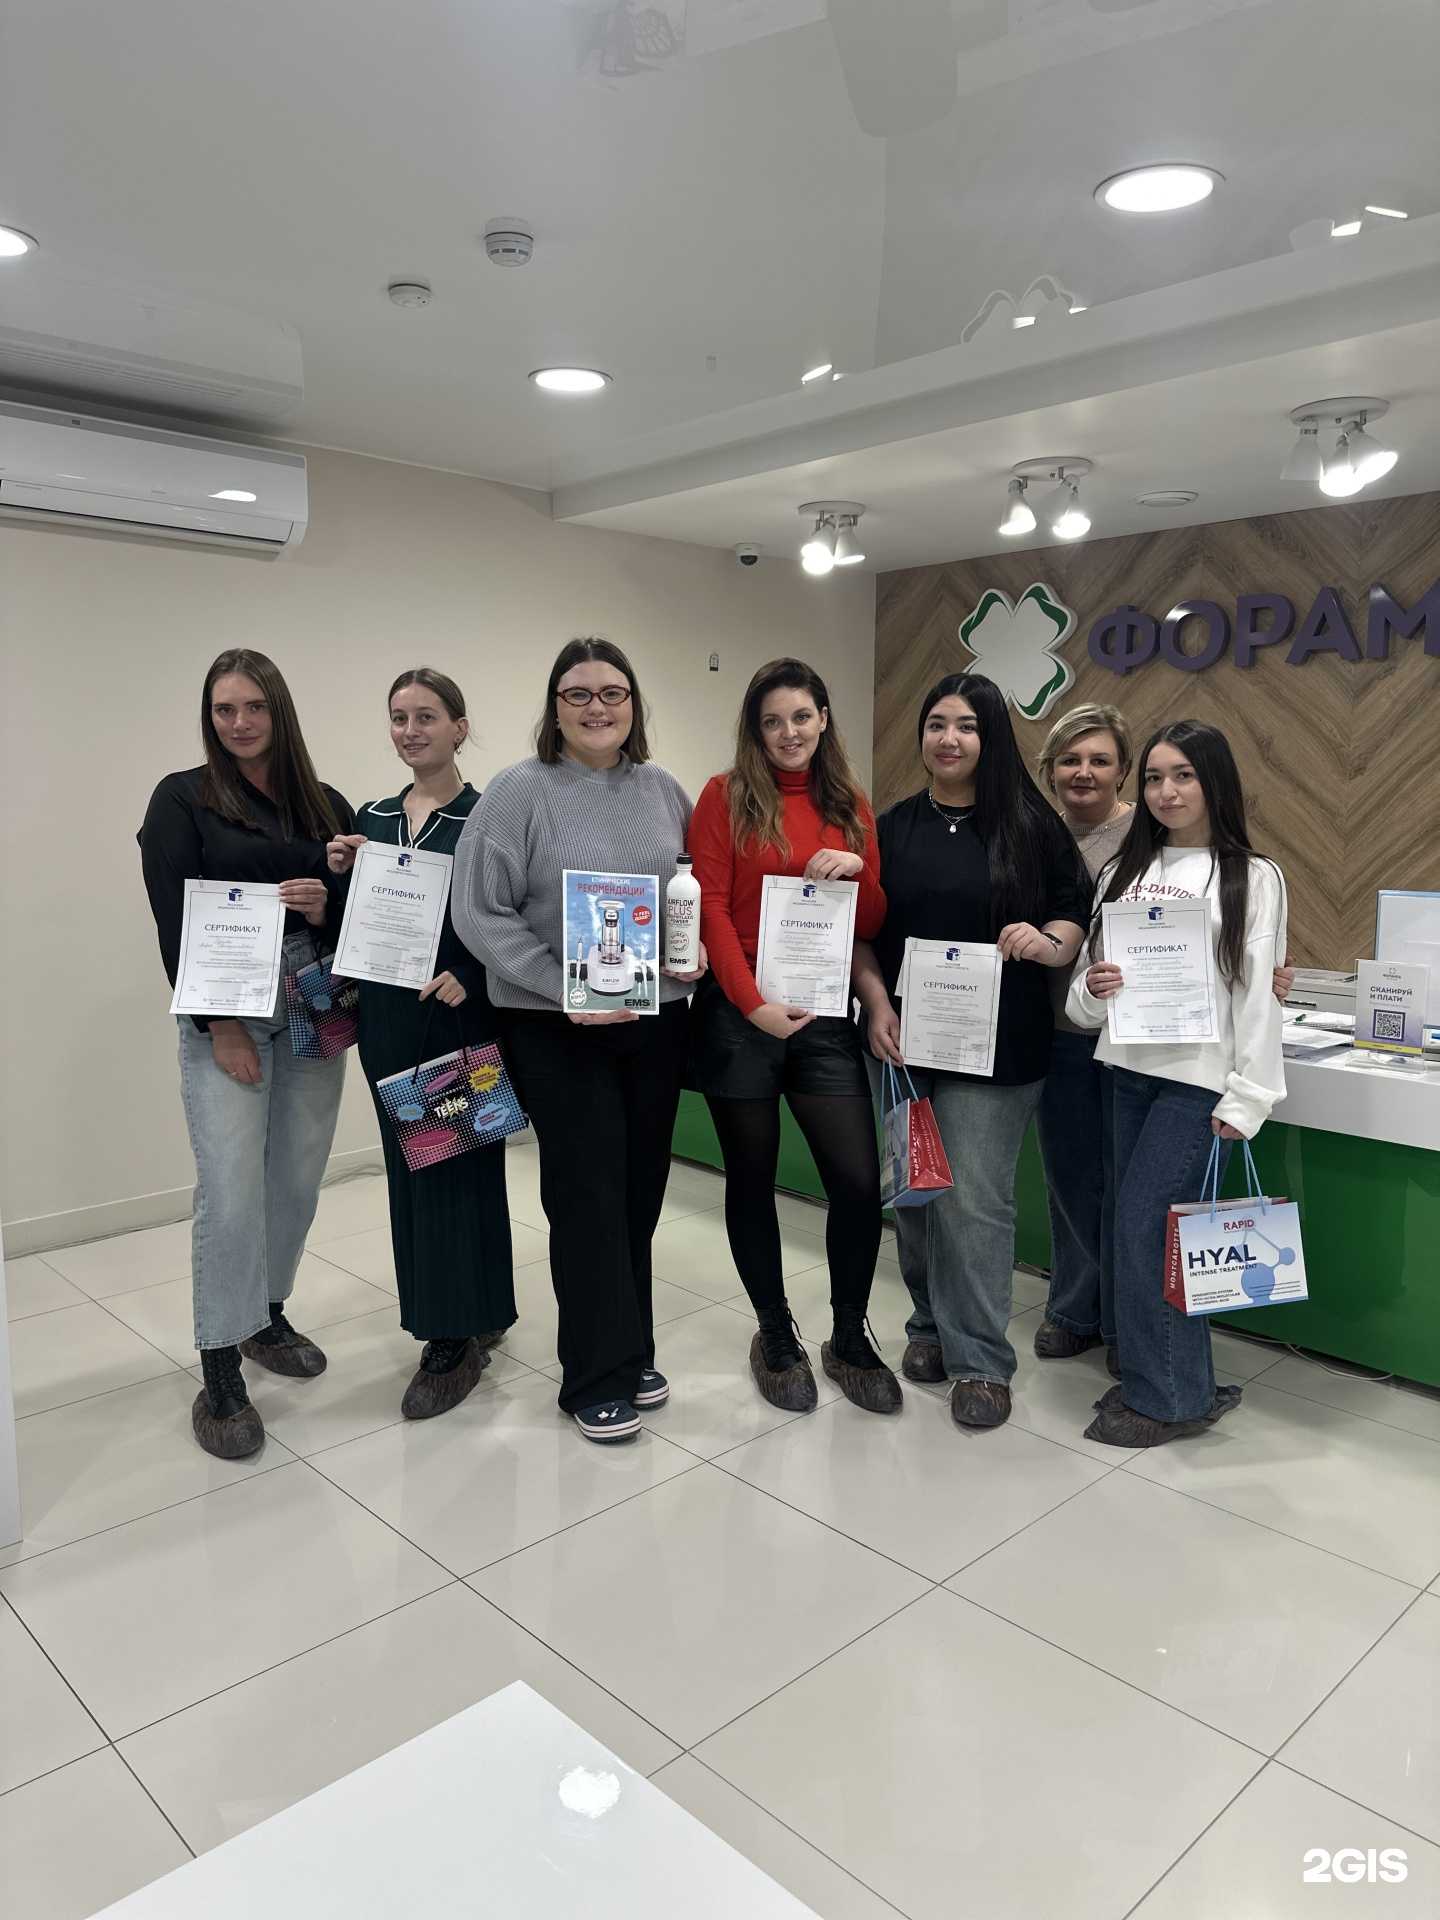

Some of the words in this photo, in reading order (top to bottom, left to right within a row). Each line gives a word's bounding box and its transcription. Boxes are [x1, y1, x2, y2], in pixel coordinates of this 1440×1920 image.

[371, 885, 427, 901] СЕРТИФИКАТ
[576, 882, 645, 897] РЕКОМЕНДАЦИИ
[668, 906, 693, 916] PLUS
[204, 923, 262, 934] СЕРТИФИКАТ
[780, 919, 834, 930] СЕРТИФИКАТ
[1127, 944, 1189, 955] СЕРТИФИКАТ
[669, 957, 688, 965] EMS
[923, 980, 979, 993] СЕРТИФИКАТ
[1370, 985, 1413, 996] СКАНИРУЙ
[624, 998, 651, 1007] EMS
[1377, 994, 1403, 1002] ПЛАТИ
[433, 1096, 470, 1119] TEENS
[1223, 1219, 1255, 1231] RAPID
[1188, 1244, 1257, 1269] HYAL
[1189, 1267, 1218, 1278] INTENSE
[1219, 1263, 1258, 1274] TREATMENT
